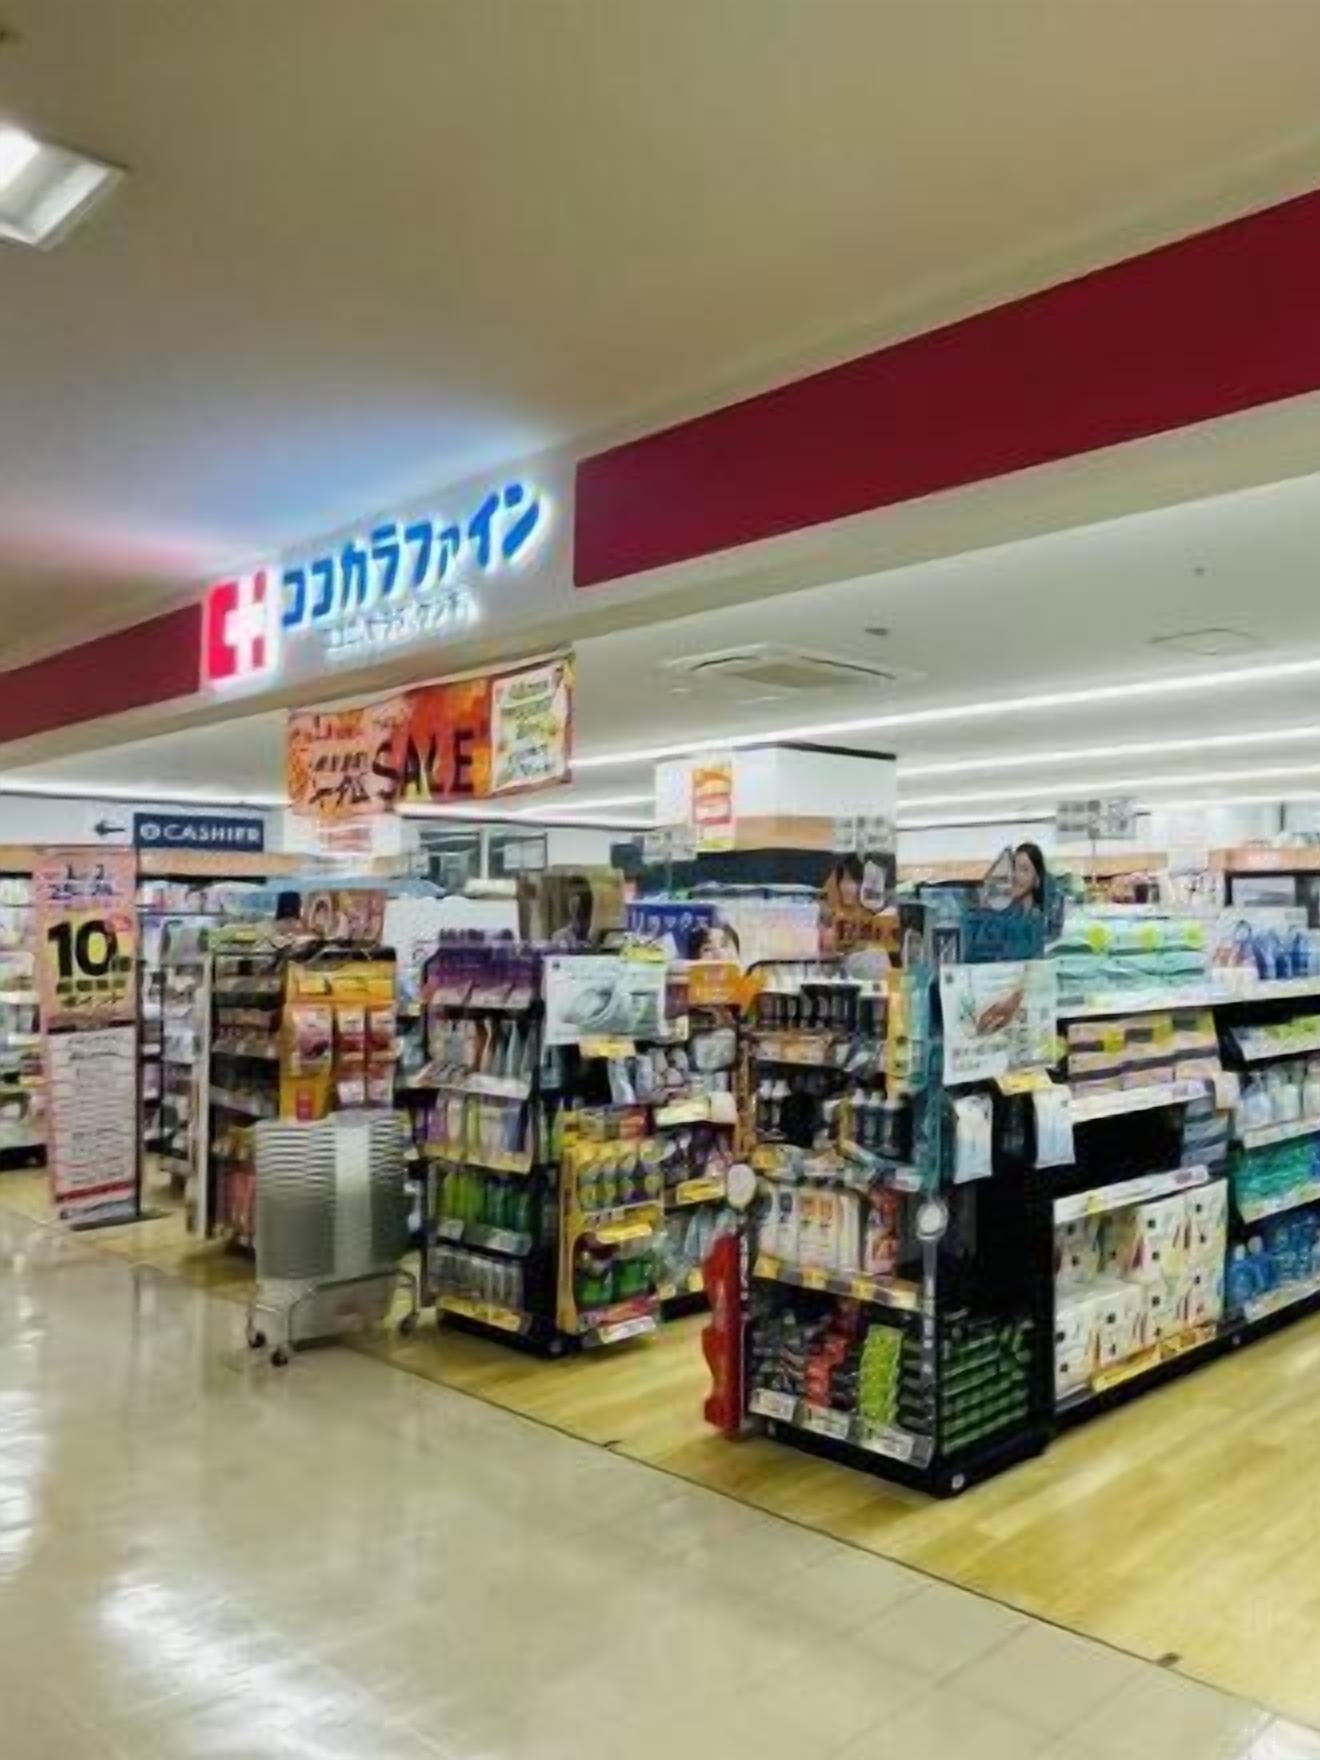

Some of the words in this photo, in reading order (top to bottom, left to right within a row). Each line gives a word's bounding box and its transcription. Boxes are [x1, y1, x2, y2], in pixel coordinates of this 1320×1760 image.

[281, 482, 541, 629] ココカラファイン
[372, 728, 476, 801] SALE
[163, 822, 260, 844] CASHIER
[47, 919, 118, 977] 10
